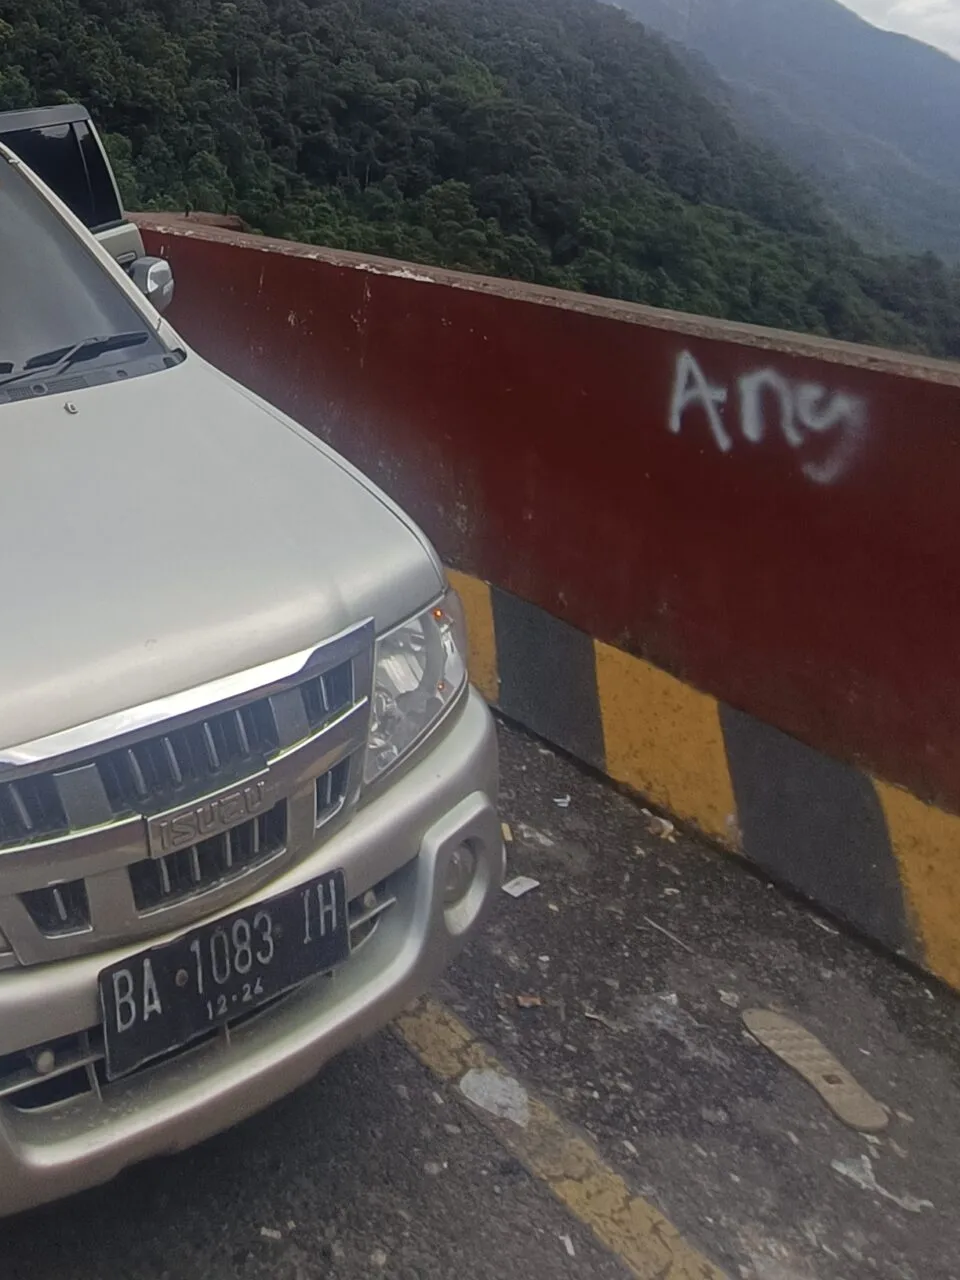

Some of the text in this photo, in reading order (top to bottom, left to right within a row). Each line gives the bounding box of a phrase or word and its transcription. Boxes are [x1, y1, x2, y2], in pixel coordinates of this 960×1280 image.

[159, 780, 267, 851] ISUZU
[112, 958, 162, 1033] BA
[190, 911, 275, 994] 1083
